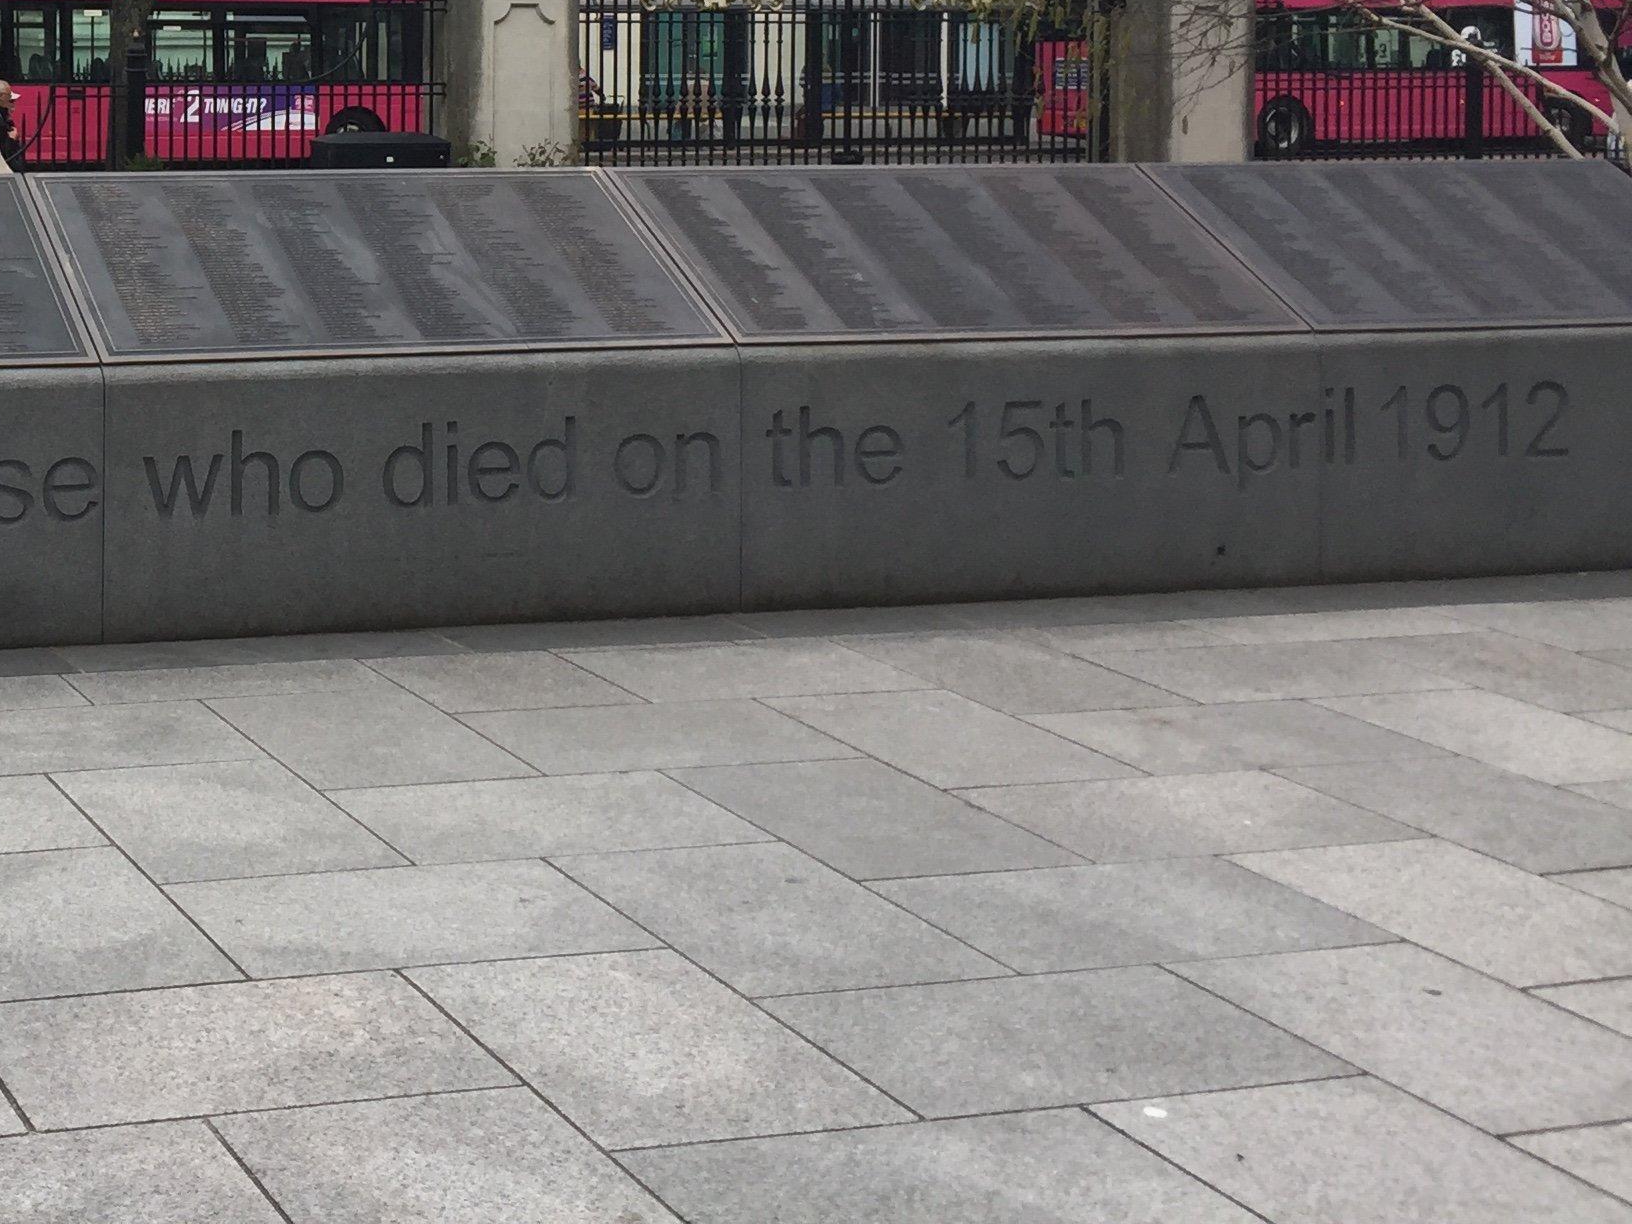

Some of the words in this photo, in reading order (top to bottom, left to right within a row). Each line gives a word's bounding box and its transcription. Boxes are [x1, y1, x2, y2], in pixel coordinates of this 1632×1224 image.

[179, 89, 200, 123] 2
[142, 429, 345, 517] who
[382, 415, 576, 508] died
[613, 431, 721, 497] on
[765, 405, 903, 488] the
[947, 398, 1126, 481] 15th
[1167, 386, 1357, 490] April
[1379, 379, 1570, 462] 1912
